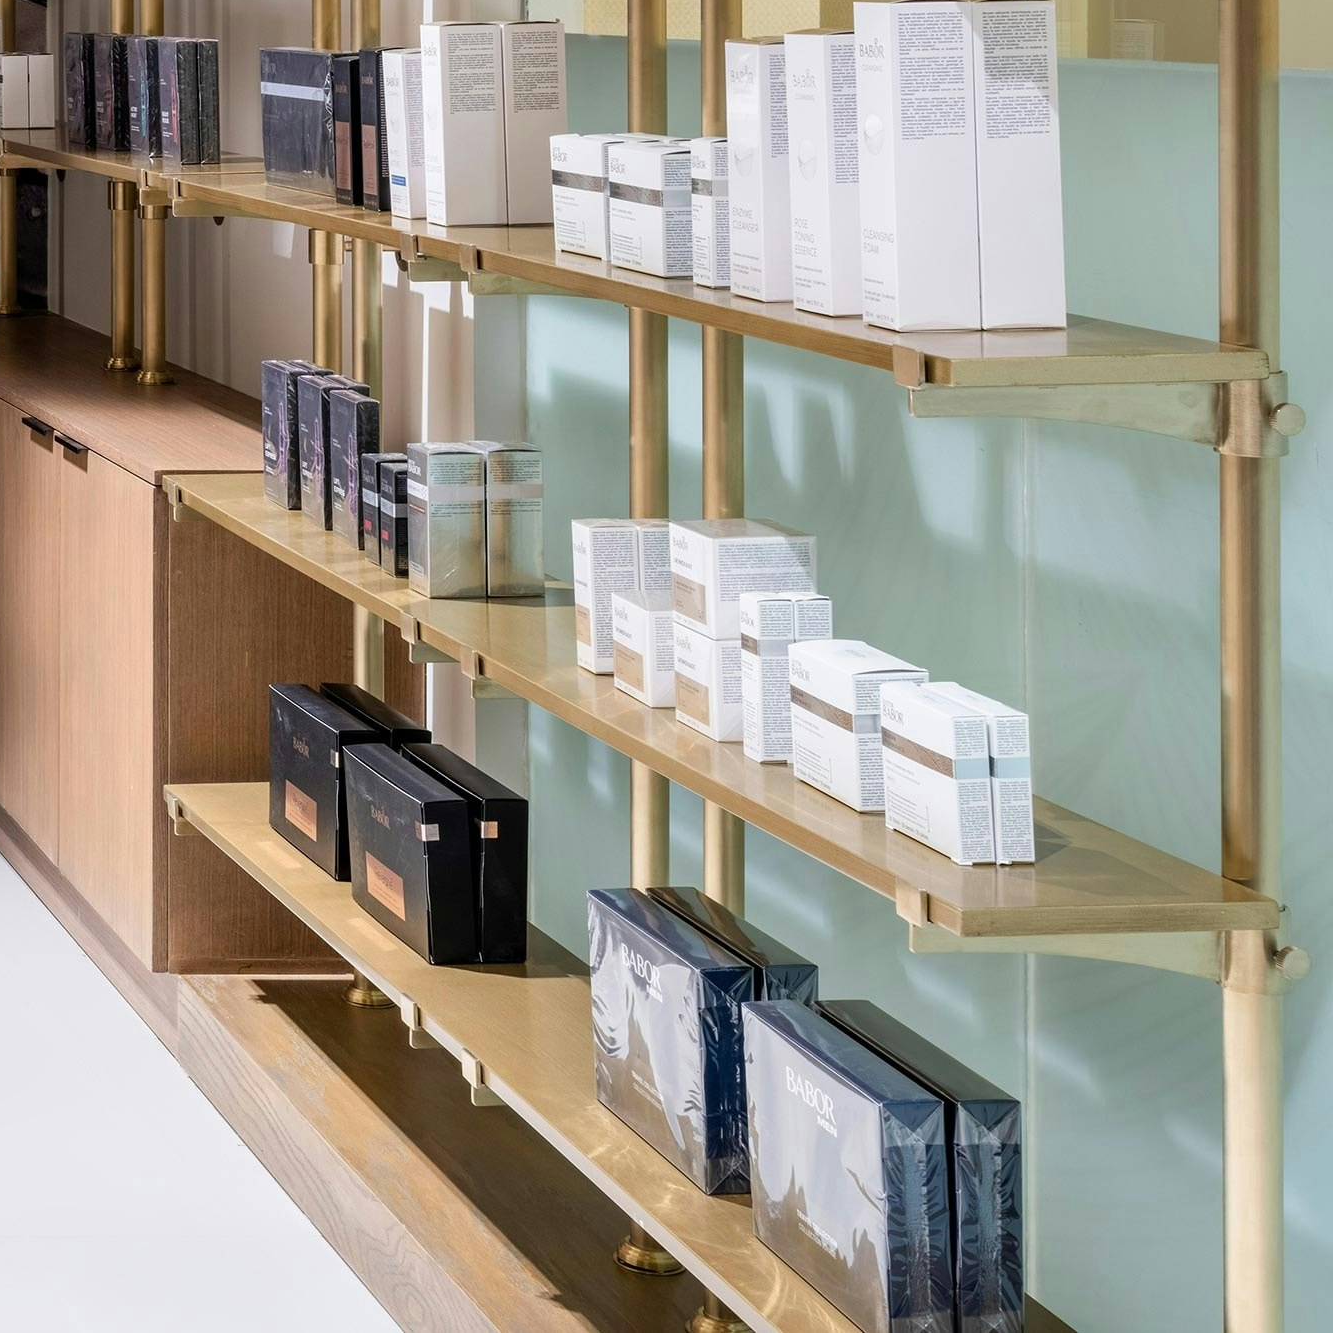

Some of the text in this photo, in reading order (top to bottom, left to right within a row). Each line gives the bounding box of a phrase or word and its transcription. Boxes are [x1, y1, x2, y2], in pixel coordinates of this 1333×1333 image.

[859, 44, 884, 58] BABOR
[732, 219, 759, 234] CLEANSER
[863, 228, 894, 243] CLEANSING
[791, 665, 810, 682] BABOR
[883, 706, 904, 726] BABOR
[293, 737, 309, 759] BABOR
[371, 805, 390, 830] BABOR
[621, 942, 662, 992] BABOR
[646, 985, 663, 1003] MEN
[786, 1066, 836, 1124] BABOR
[817, 1115, 837, 1138] MEN
